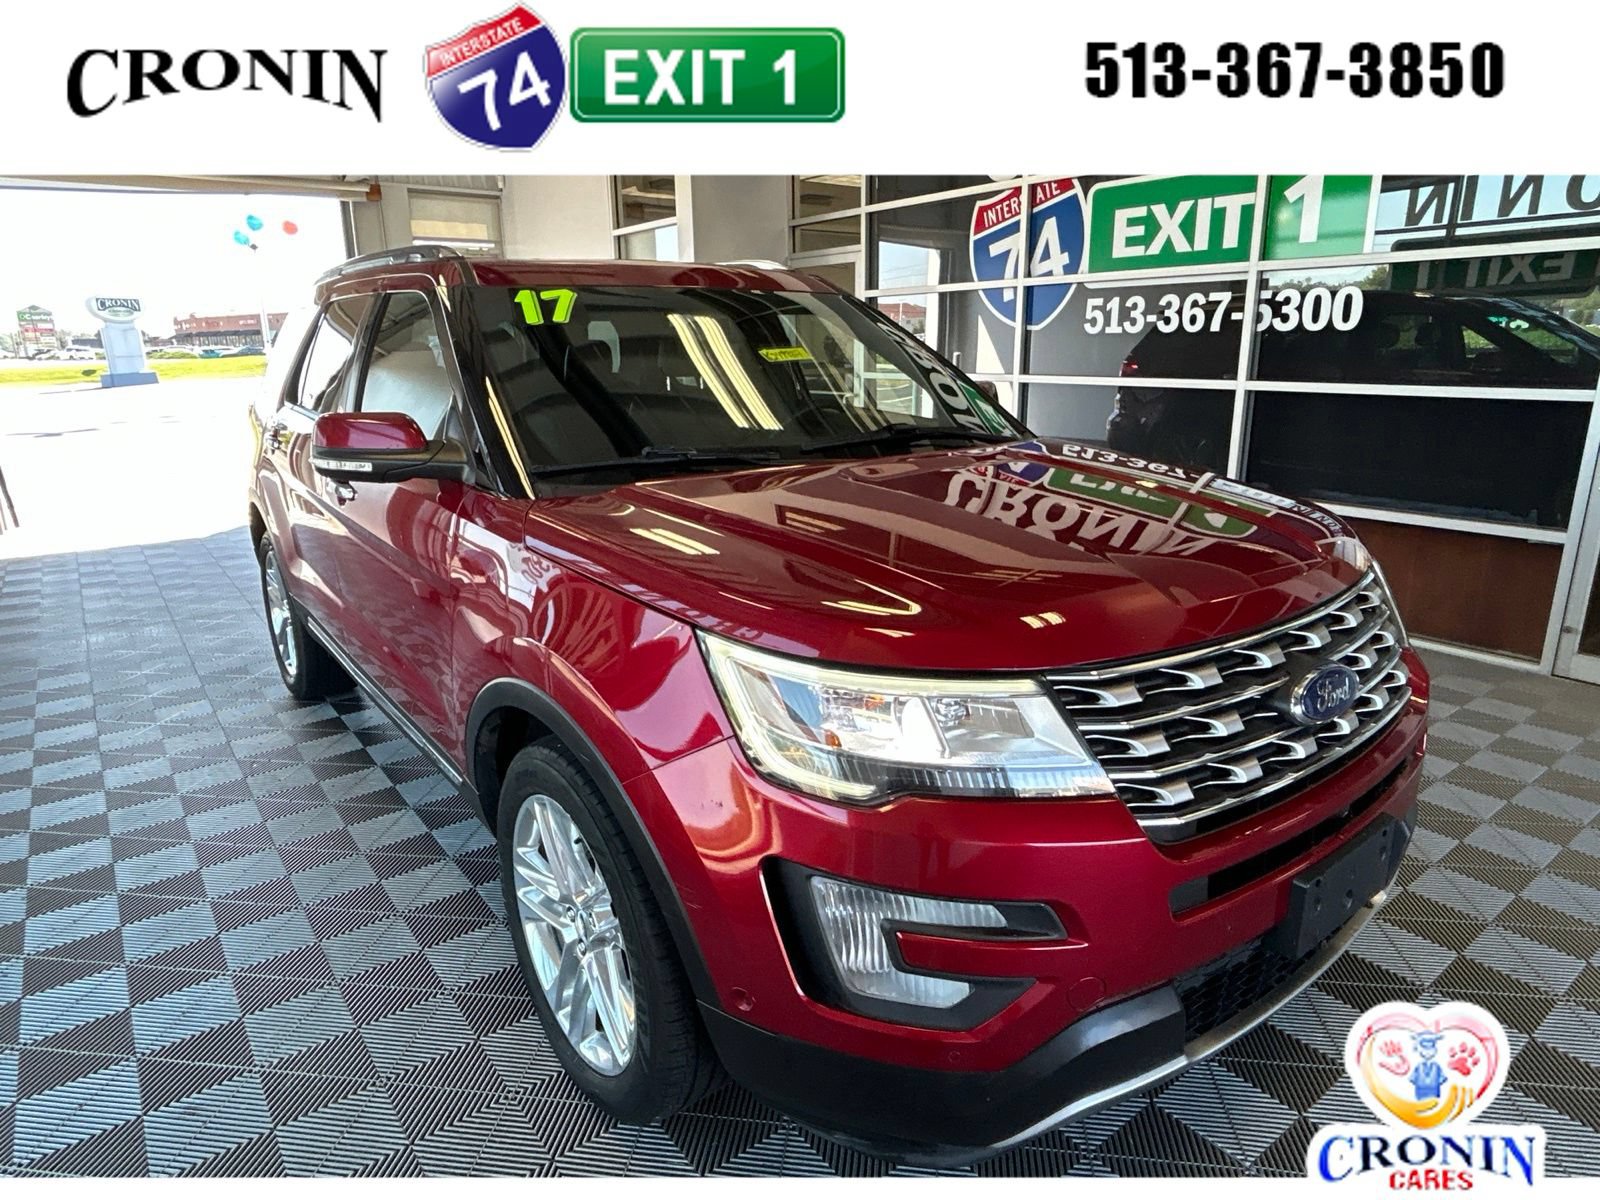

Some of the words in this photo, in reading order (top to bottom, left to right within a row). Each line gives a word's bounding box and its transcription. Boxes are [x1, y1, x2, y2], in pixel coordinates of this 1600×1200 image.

[983, 182, 1061, 228] INTERATE
[1112, 191, 1257, 259] EXIT
[1284, 175, 1325, 244] 1
[989, 216, 1069, 303] 74
[97, 298, 140, 311] CRONIN
[514, 288, 577, 326] 17
[1083, 285, 1364, 336] 513-367-5300
[1316, 676, 1351, 713] Ford
